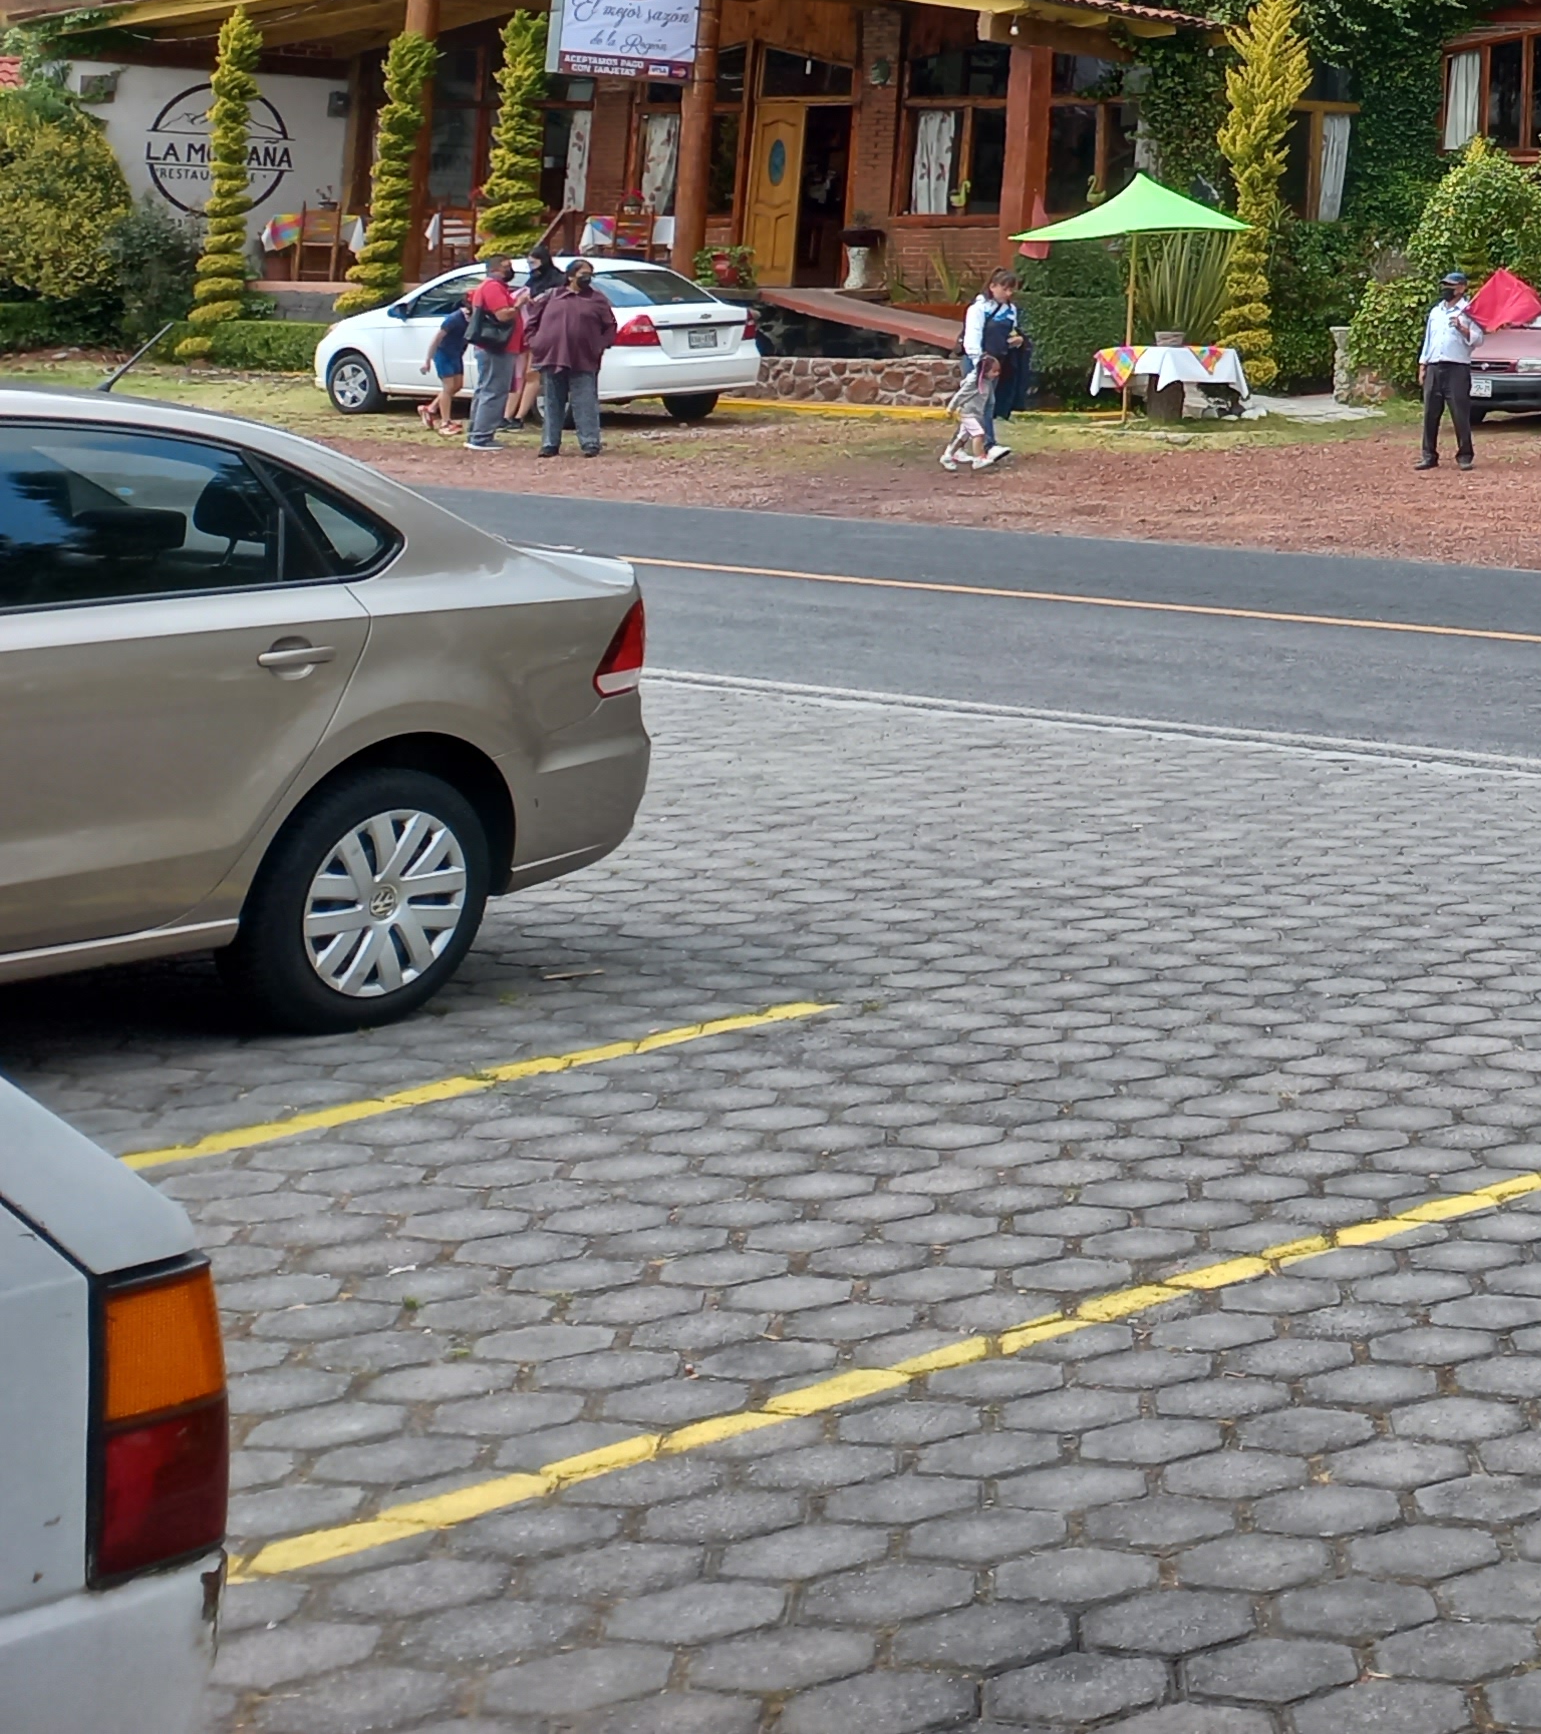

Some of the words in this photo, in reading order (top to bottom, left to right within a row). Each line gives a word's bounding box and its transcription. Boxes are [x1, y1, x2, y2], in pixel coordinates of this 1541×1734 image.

[603, 3, 642, 28] mejor
[644, 6, 690, 28] sazón
[564, 54, 618, 67] ACEPTAMOS
[571, 63, 591, 73] CON
[594, 66, 636, 77] TARJETAS
[145, 141, 180, 163] LA
[186, 140, 293, 168] MAÑA
[158, 168, 256, 184] RESTAUE
